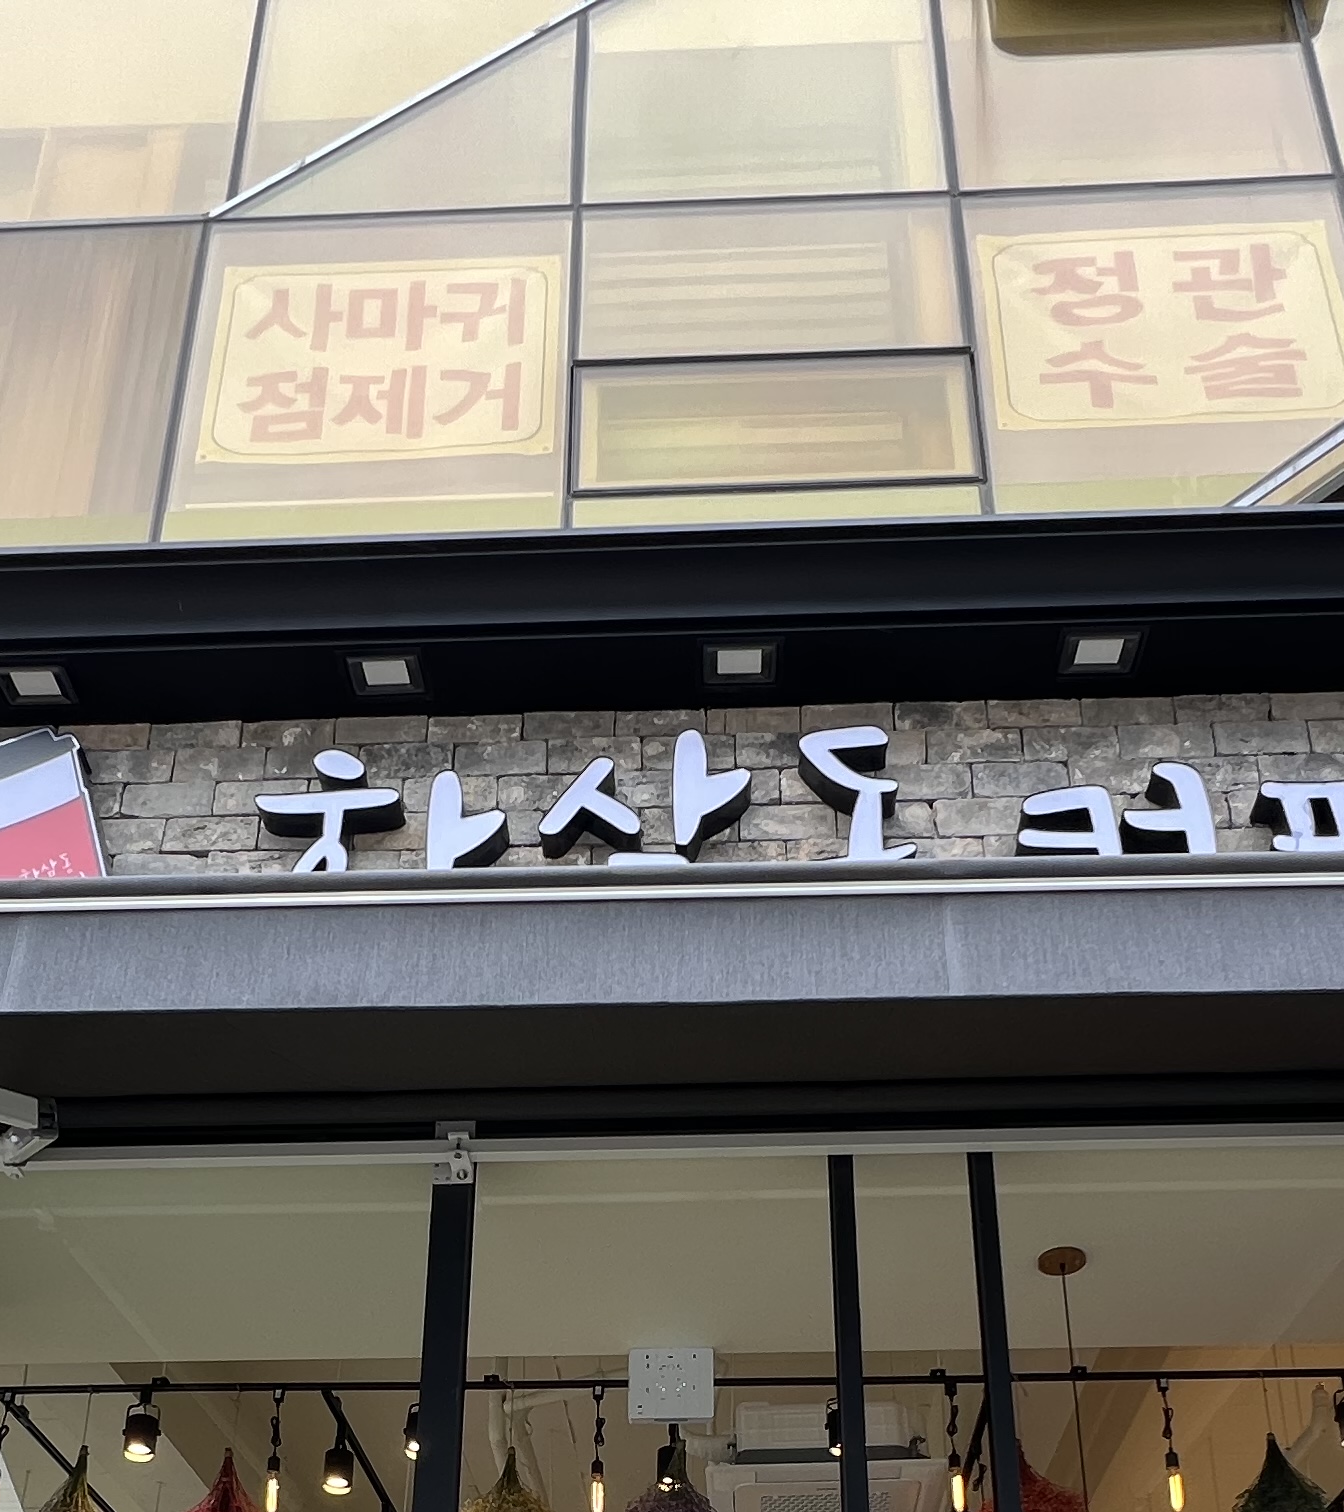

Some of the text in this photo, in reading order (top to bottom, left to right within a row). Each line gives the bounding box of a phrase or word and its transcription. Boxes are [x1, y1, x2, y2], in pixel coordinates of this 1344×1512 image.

[244, 278, 527, 352] 사마귀
[236, 362, 522, 442] 점제거
[1039, 332, 1307, 409] 수술
